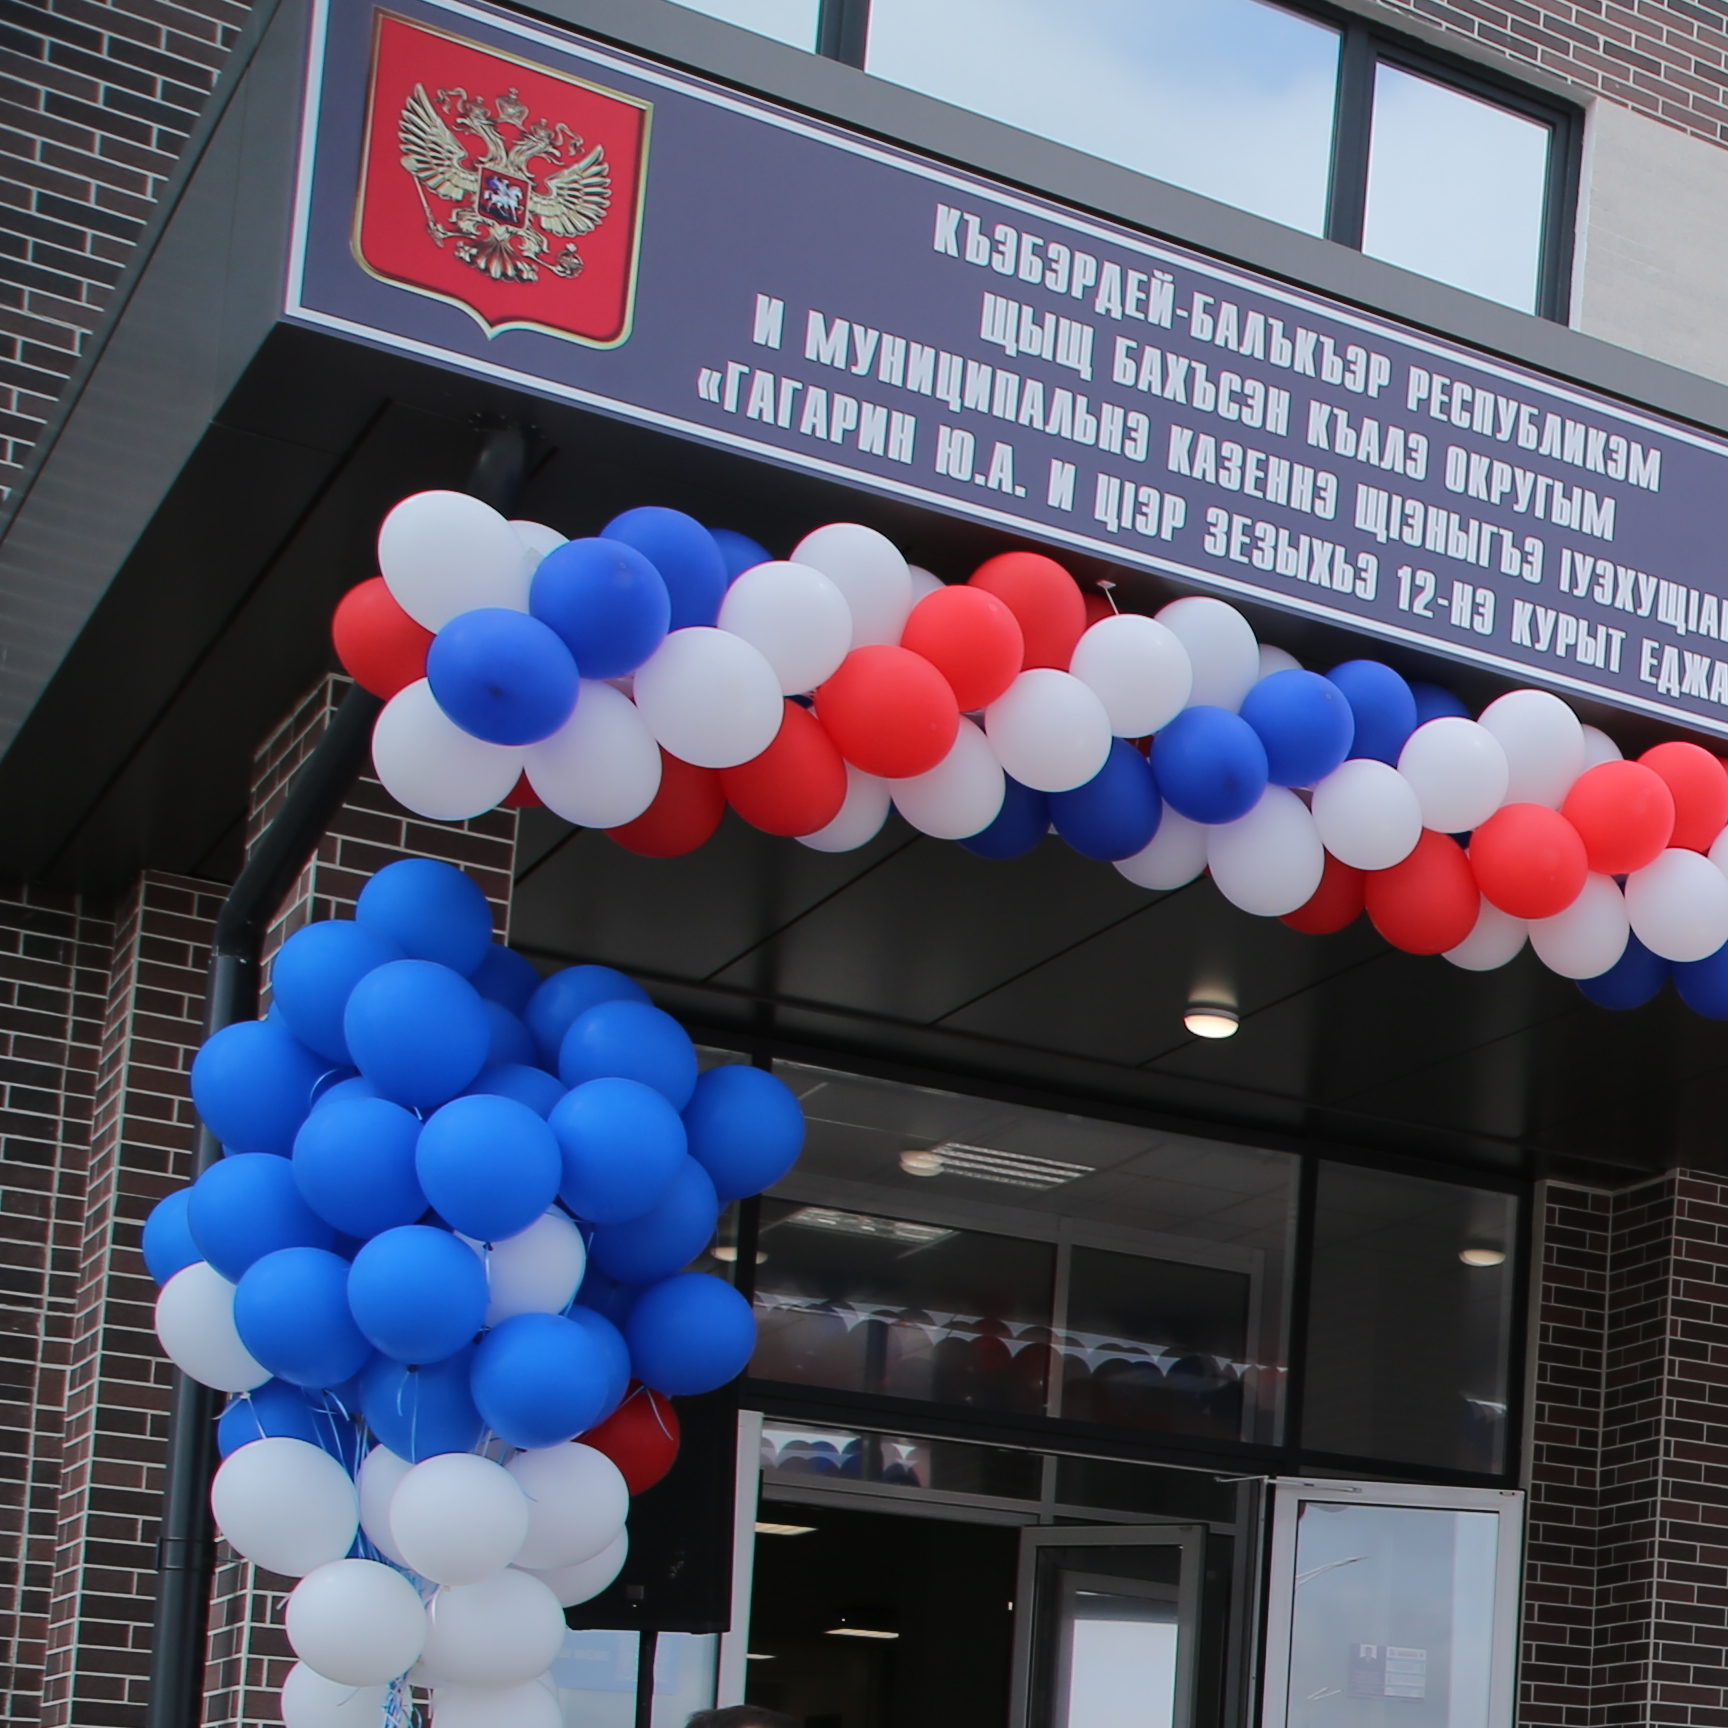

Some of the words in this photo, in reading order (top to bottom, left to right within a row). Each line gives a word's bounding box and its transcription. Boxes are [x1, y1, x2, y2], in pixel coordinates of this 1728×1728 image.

[754, 294, 783, 349] И
[805, 310, 1149, 461] МУНИЦИПАЛЬНЭ
[1168, 425, 1337, 519] КАЗЕННЭ
[934, 204, 1390, 398] КЪЭБЭРДЕЙ-БАЛЪКЪЭР
[1407, 366, 1660, 492] РЕСПУБЛИКЭМ
[981, 292, 1093, 381] ЩЫЩ
[1113, 336, 1289, 436] БАХЪСЭН
[1308, 400, 1427, 480] КЪАЛЭ
[1446, 446, 1615, 541] ОКРУГЫМ
[698, 361, 915, 464] «ГАГАРИН
[936, 425, 1025, 497] Ю.А.
[1048, 459, 1075, 511] И
[1398, 566, 1494, 634] 12-НЭ
[1512, 600, 1625, 672] КУРЫТ
